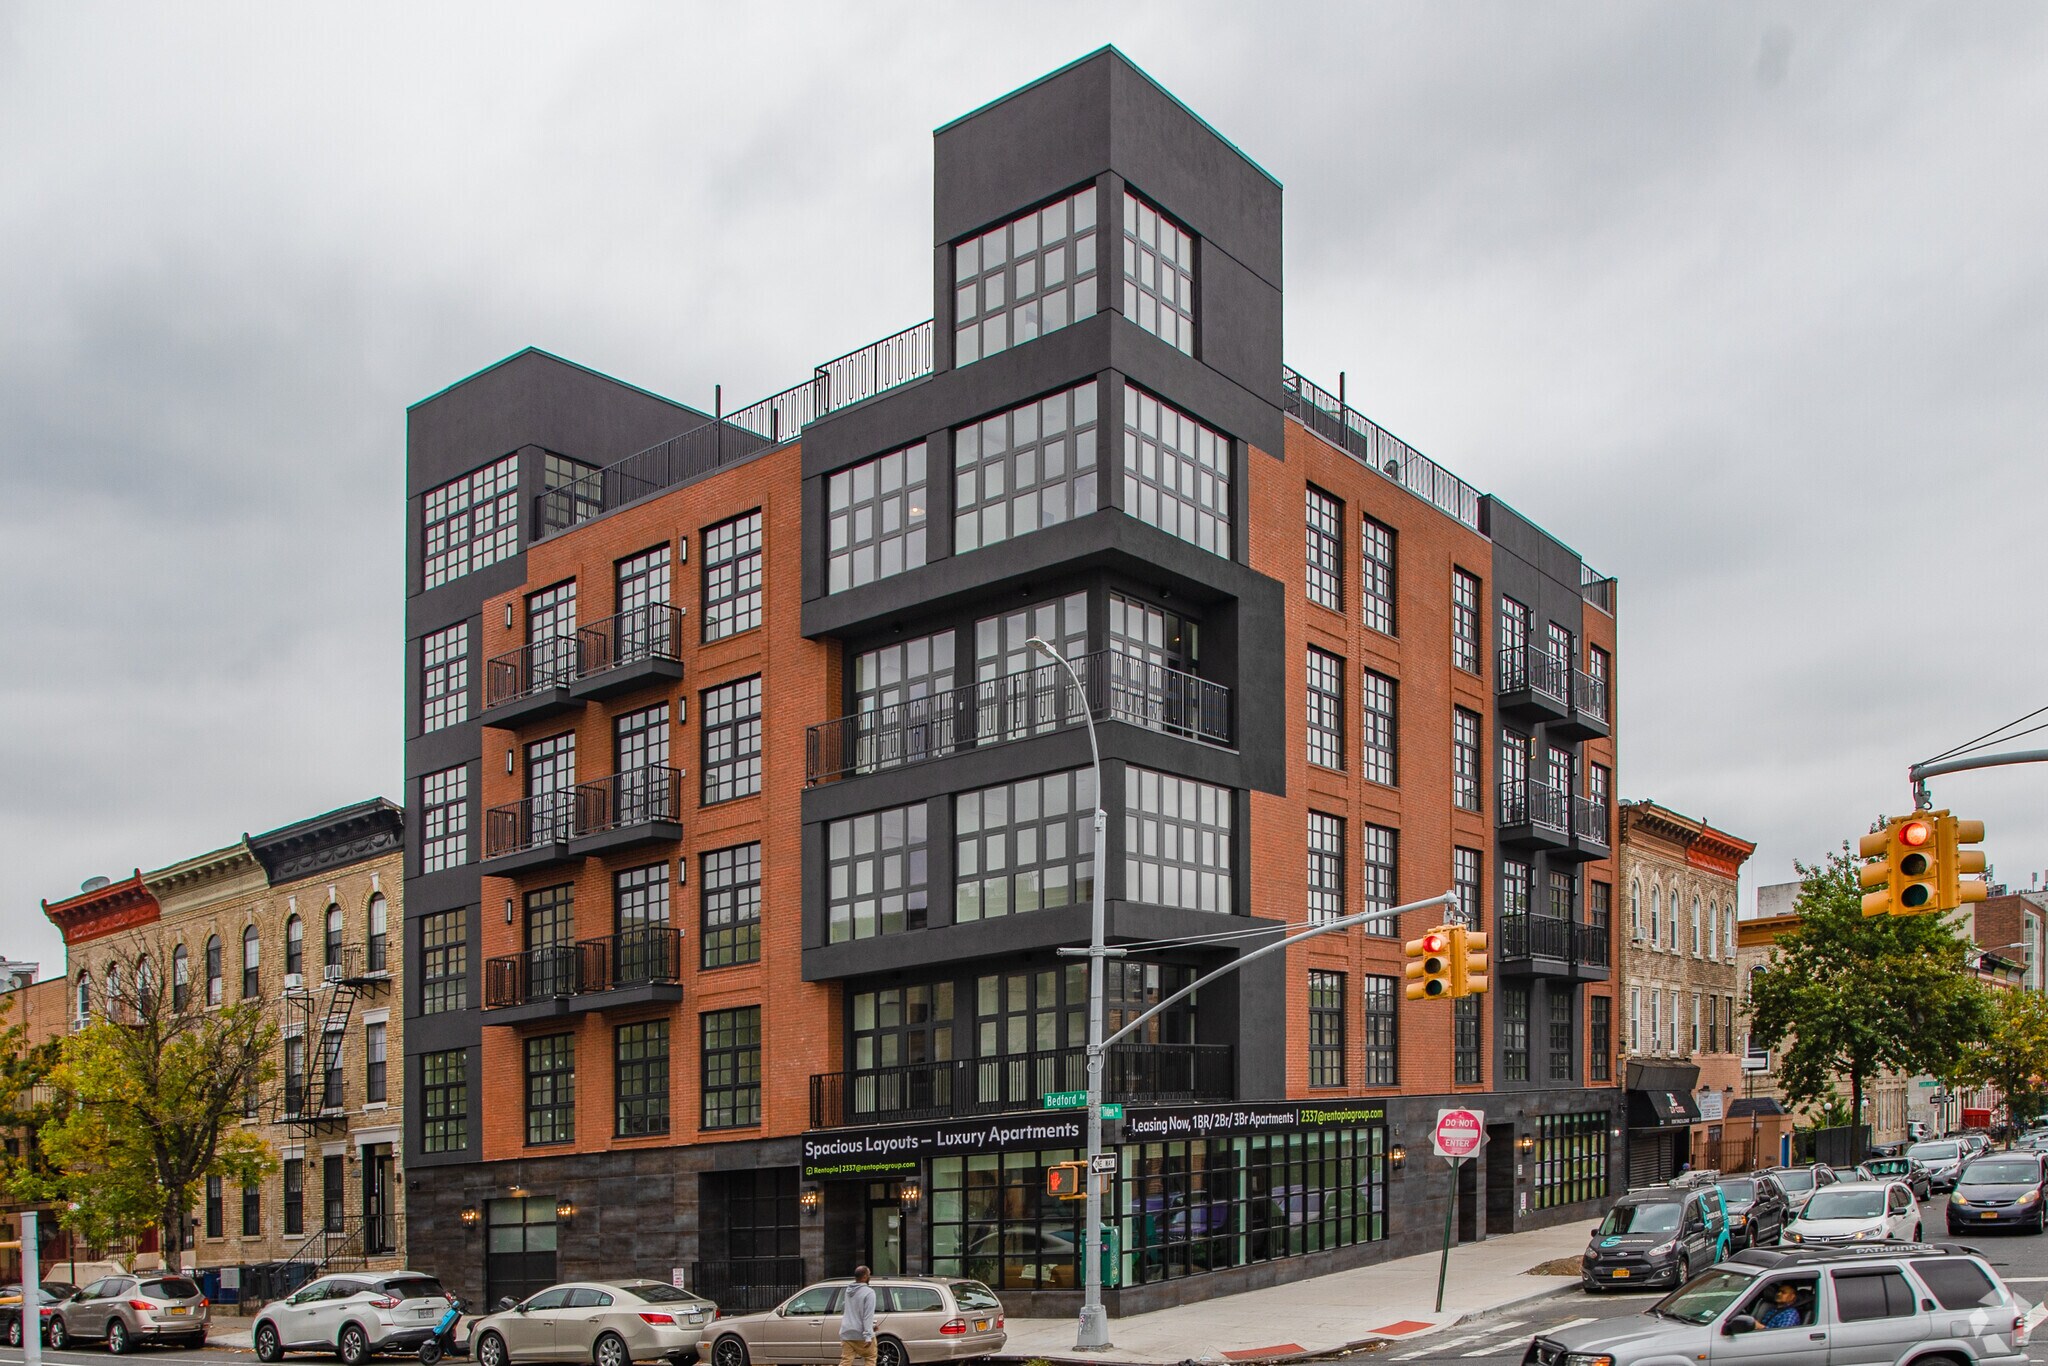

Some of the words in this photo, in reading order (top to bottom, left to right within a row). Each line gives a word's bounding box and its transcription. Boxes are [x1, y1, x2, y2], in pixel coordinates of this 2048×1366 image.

[1047, 1094, 1077, 1107] Bedford
[1132, 1116, 1168, 1134] Leasing
[1169, 1115, 1191, 1131] Now,
[1249, 1111, 1294, 1128] Apartments
[1301, 1107, 1384, 1125] 2337@rentopiagroup.com
[1445, 1118, 1456, 1127] DO
[1458, 1119, 1474, 1128] NOT
[805, 1139, 863, 1159] Spacious
[865, 1135, 919, 1154] Layouts
[937, 1130, 986, 1147] Luxury
[988, 1122, 1079, 1145] Apartments
[1445, 1139, 1470, 1147] ENTER
[813, 1165, 839, 1175] Rentopia
[842, 1162, 916, 1173] 2337@rentopiagroup.com
[1095, 1160, 1103, 1168] ONE
[1856, 1243, 1934, 1254] PATHFINDER
